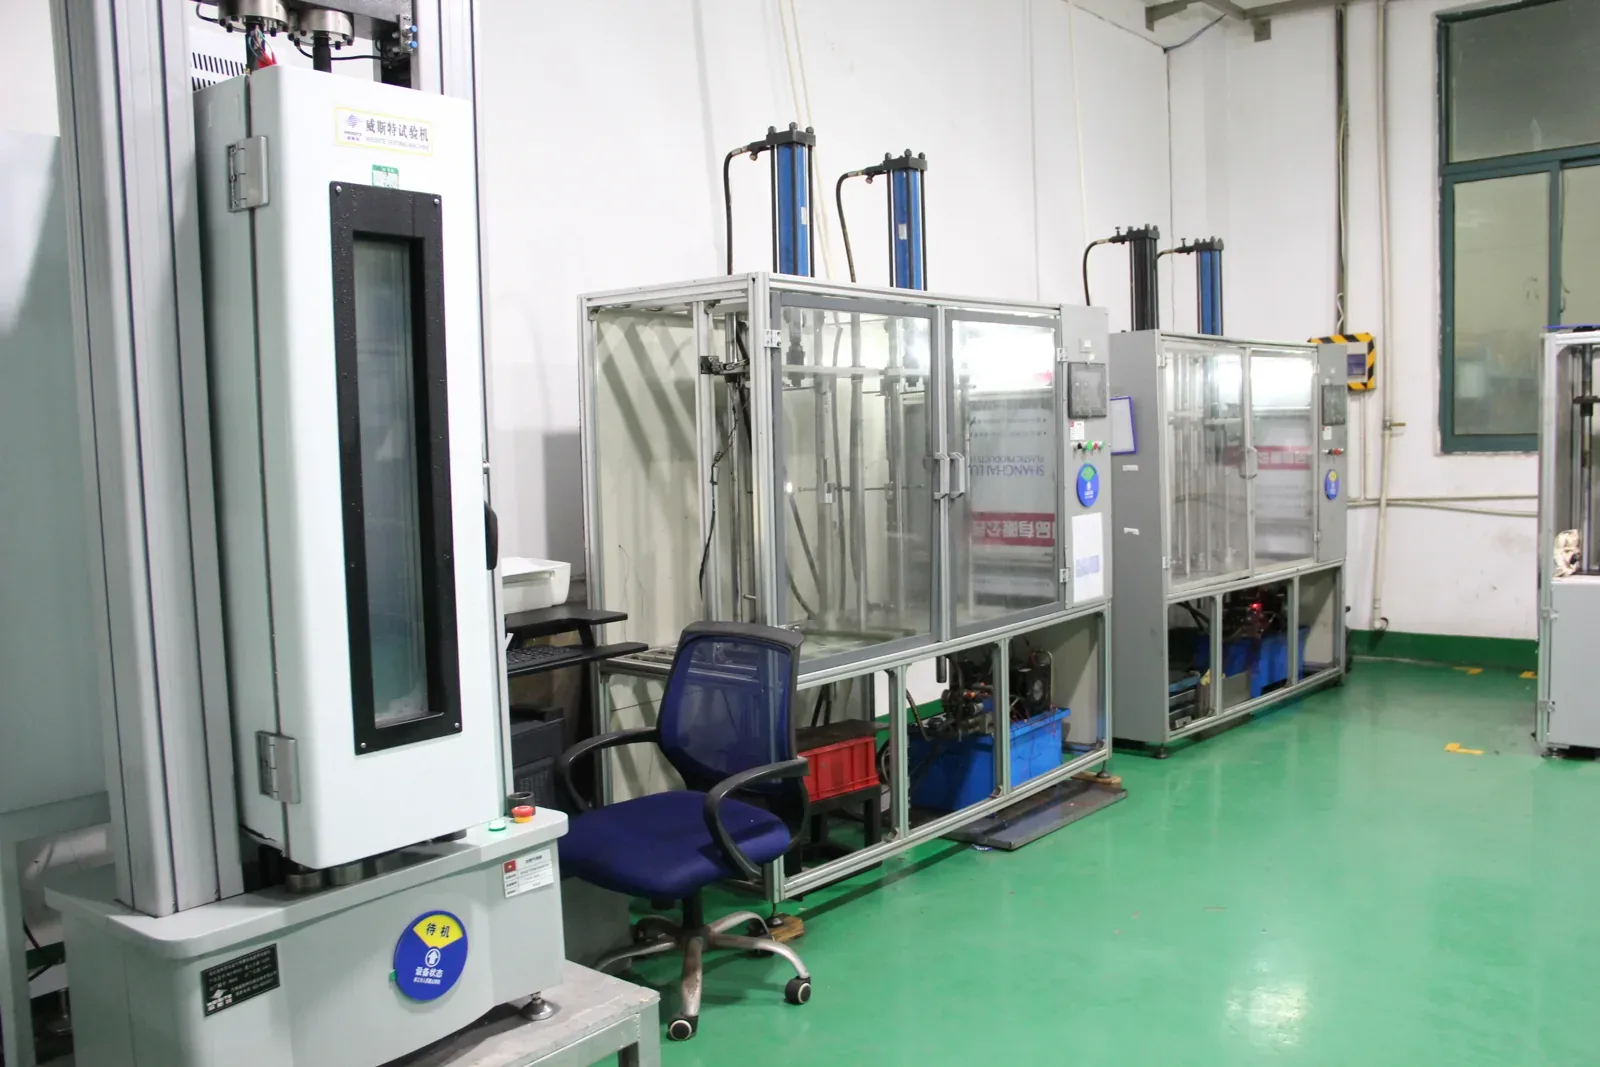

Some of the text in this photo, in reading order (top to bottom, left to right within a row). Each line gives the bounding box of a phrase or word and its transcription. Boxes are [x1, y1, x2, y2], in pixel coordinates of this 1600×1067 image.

[366, 118, 428, 142] 威斯特试验机
[986, 464, 1044, 476] SHANGHAI
[973, 520, 1055, 540] 品有限公司
[426, 922, 450, 938] 待机
[415, 966, 443, 978] 设备状态
